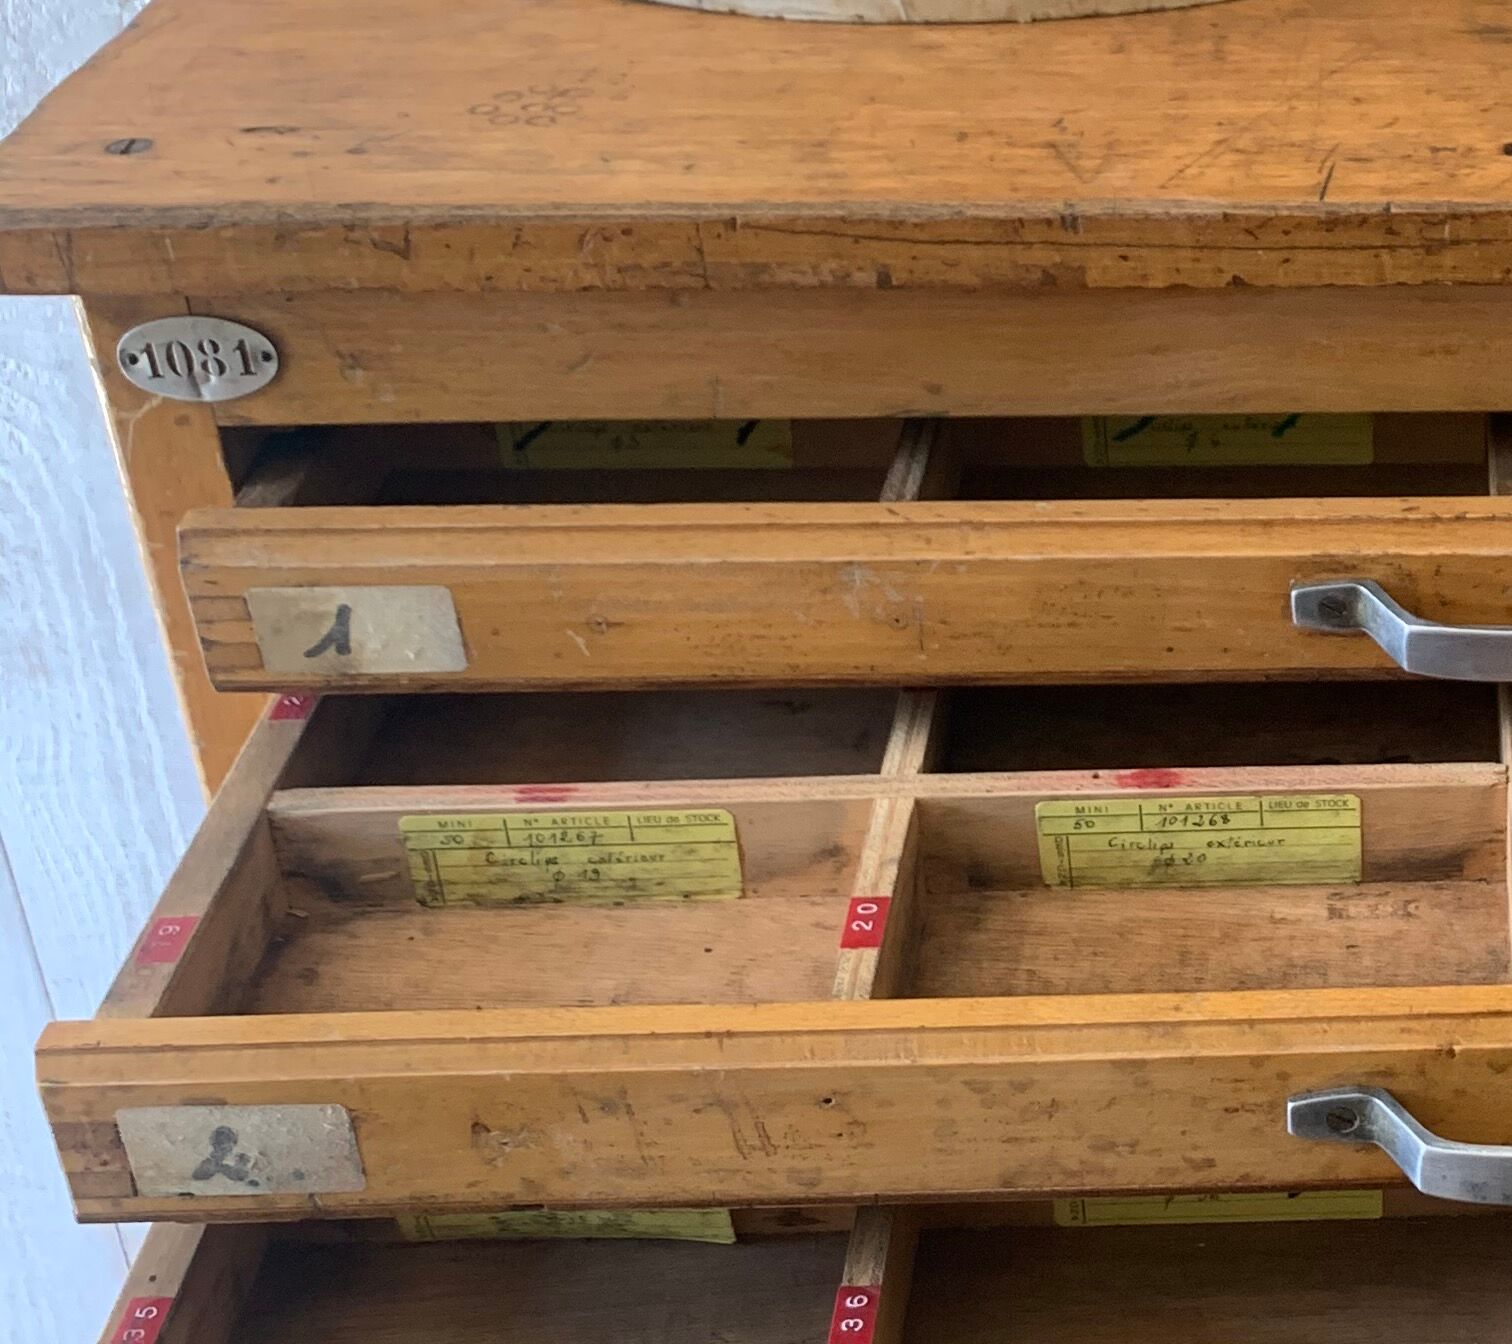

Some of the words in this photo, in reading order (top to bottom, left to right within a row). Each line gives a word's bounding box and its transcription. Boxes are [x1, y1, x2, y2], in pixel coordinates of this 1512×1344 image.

[141, 338, 258, 379] 1081
[304, 604, 352, 657] 1
[437, 819, 472, 829] MINI
[551, 816, 610, 827] ARTICLE
[684, 813, 721, 823] STOCK
[1075, 806, 1109, 814] MINI
[1185, 802, 1243, 811] ARTICLE
[1315, 799, 1350, 808] STOCK
[1073, 819, 1095, 830] 50
[852, 903, 878, 931] 20
[123, 1306, 158, 1341] 35
[841, 1295, 868, 1332] 36
